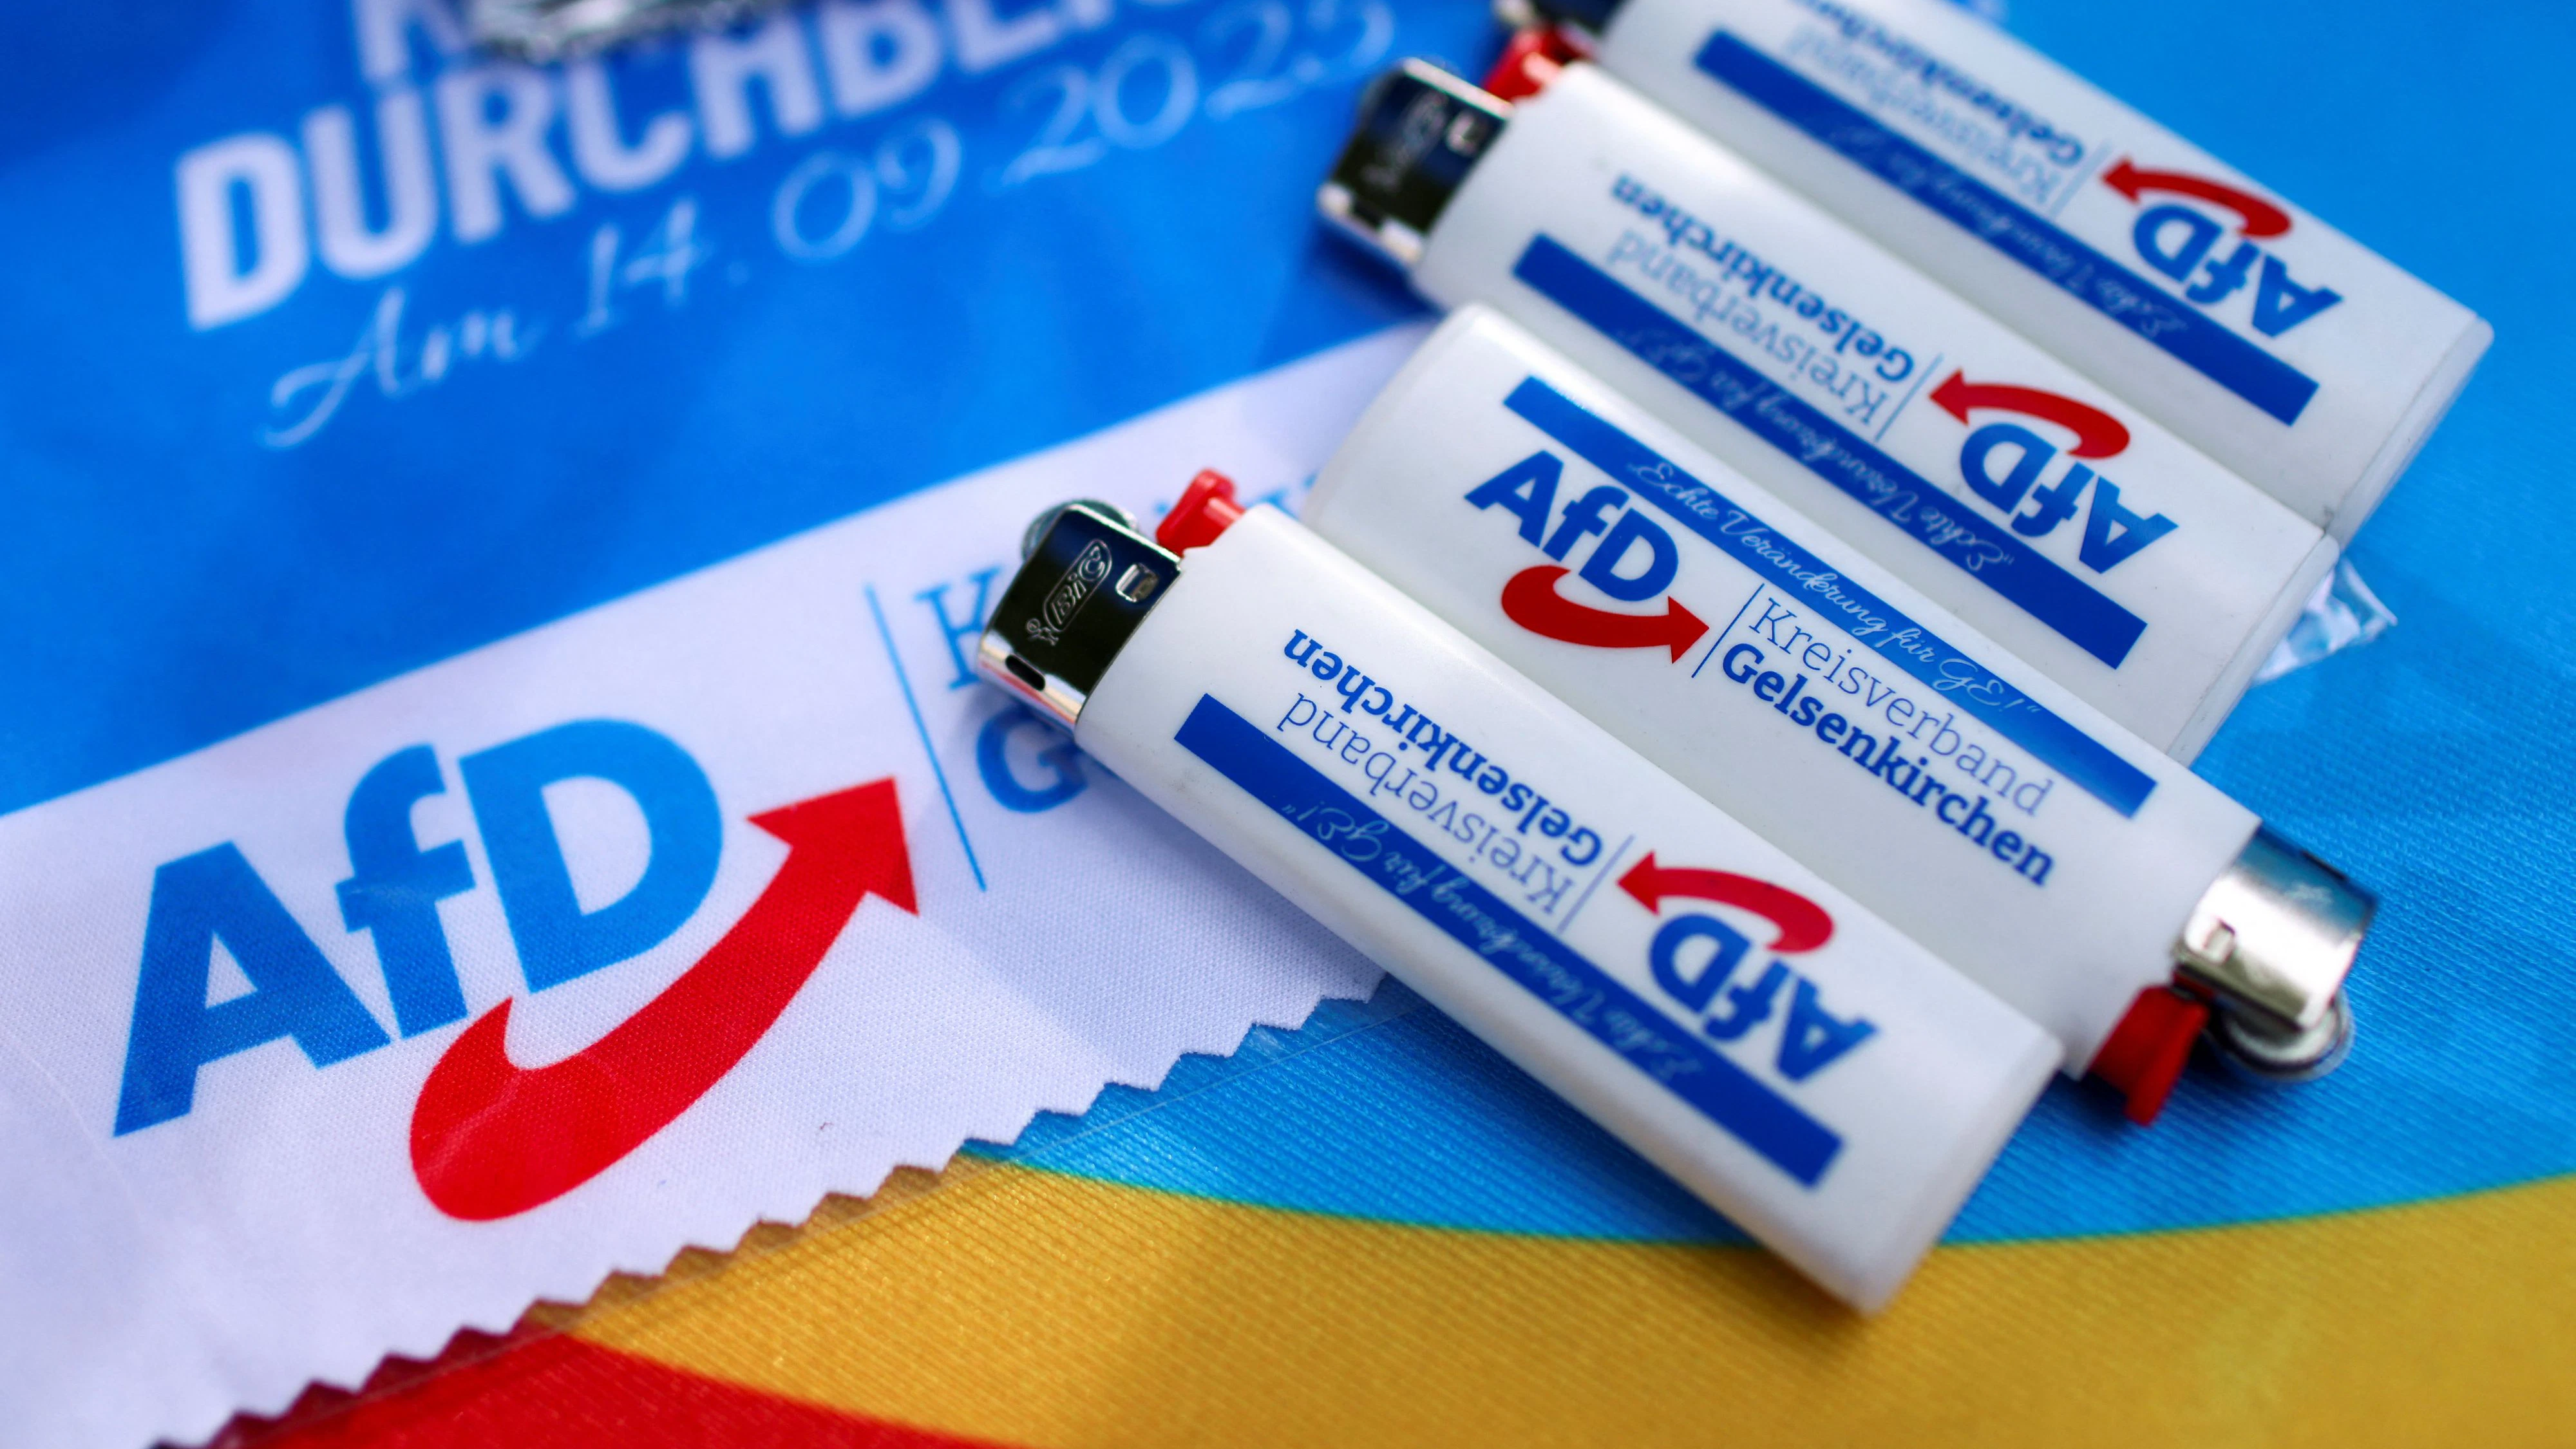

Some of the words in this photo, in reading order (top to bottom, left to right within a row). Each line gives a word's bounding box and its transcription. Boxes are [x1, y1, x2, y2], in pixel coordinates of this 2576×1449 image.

[261, 287, 546, 448] Am
[1605, 230, 1889, 425] Kreisverband
[1610, 174, 1914, 382] Gelsenkirchen
[2132, 203, 2344, 338] AfD
[1464, 450, 1679, 601] AfD
[1720, 511, 1888, 636] Veränderung
[1884, 627, 1937, 663] für
[1960, 423, 2179, 574] AfD
[1276, 693, 1576, 914] Kreisverband
[1283, 629, 1604, 867] Gelsenkirchen
[1722, 643, 2056, 886] Gelsenkirchen
[1748, 596, 2054, 817] Kreisverband
[113, 717, 723, 1139] AfD
[1647, 913, 1879, 1085] AfD
